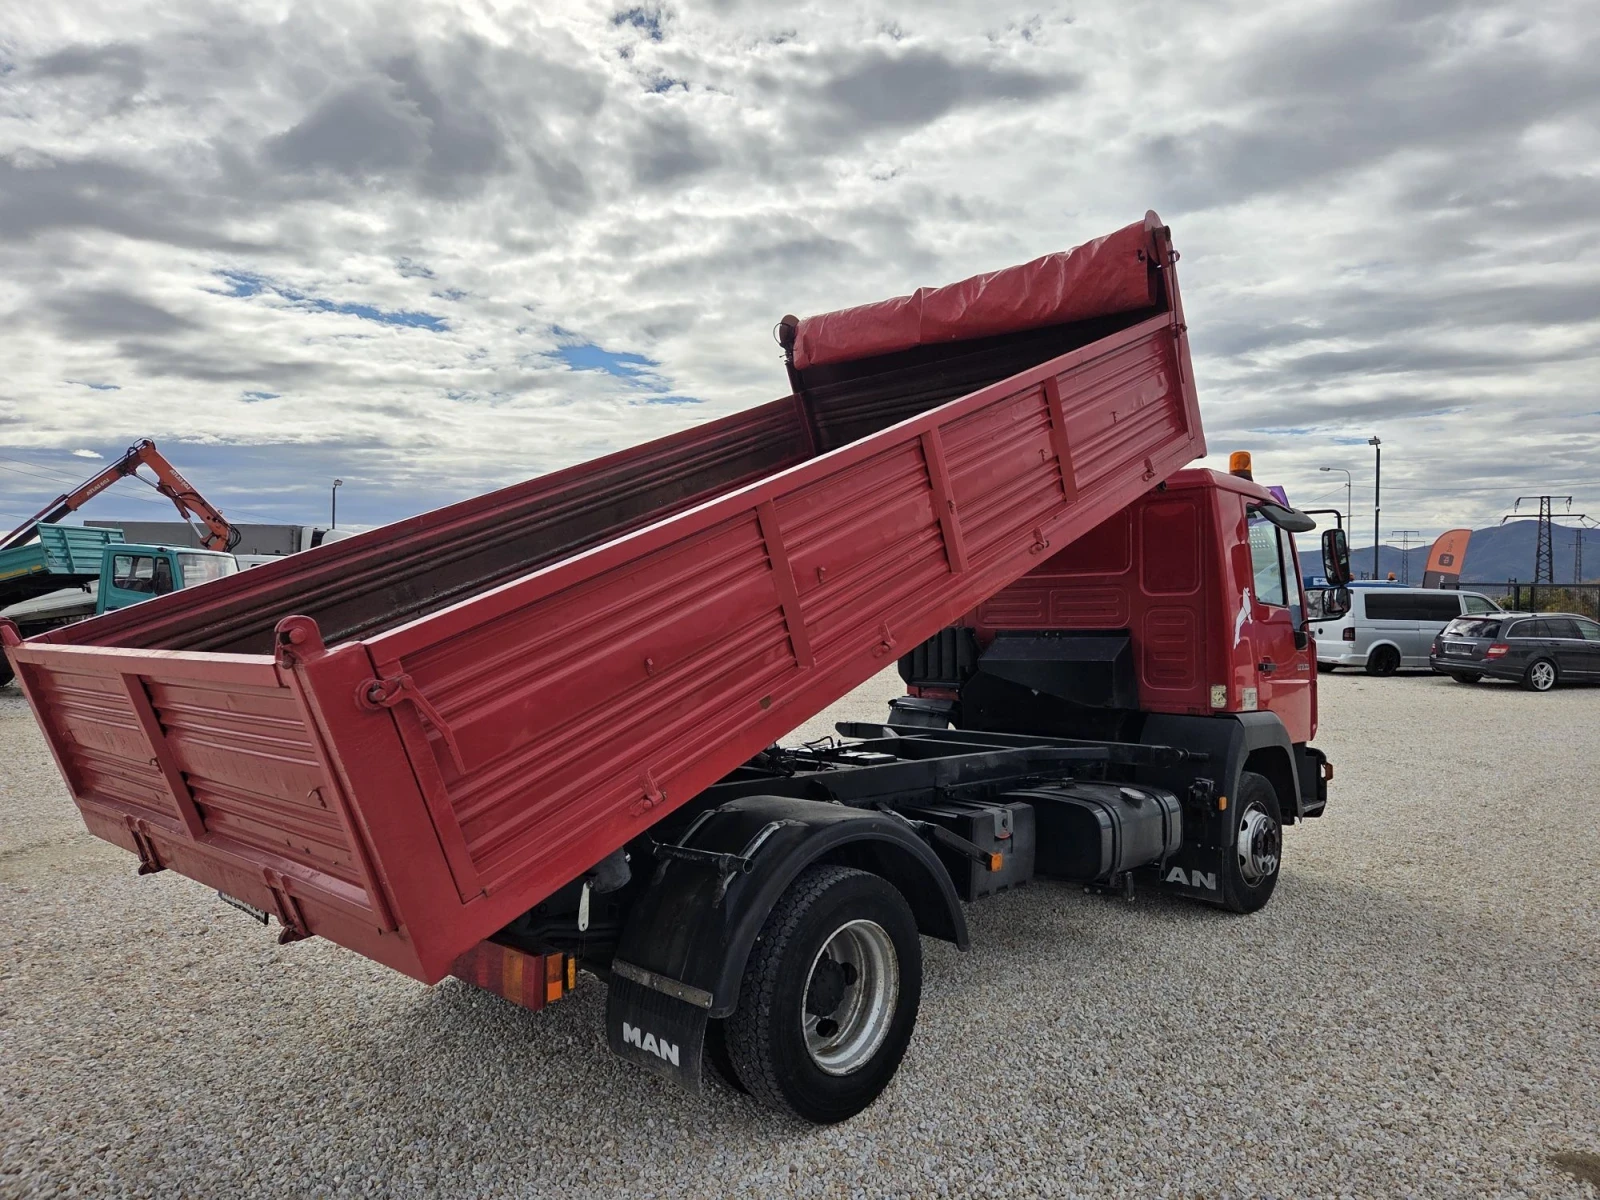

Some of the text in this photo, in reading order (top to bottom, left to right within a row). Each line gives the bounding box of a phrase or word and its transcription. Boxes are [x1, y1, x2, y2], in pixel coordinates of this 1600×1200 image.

[86, 483, 101, 496] ATLAS
[1165, 866, 1216, 890] AN
[623, 1021, 680, 1067] MAN
